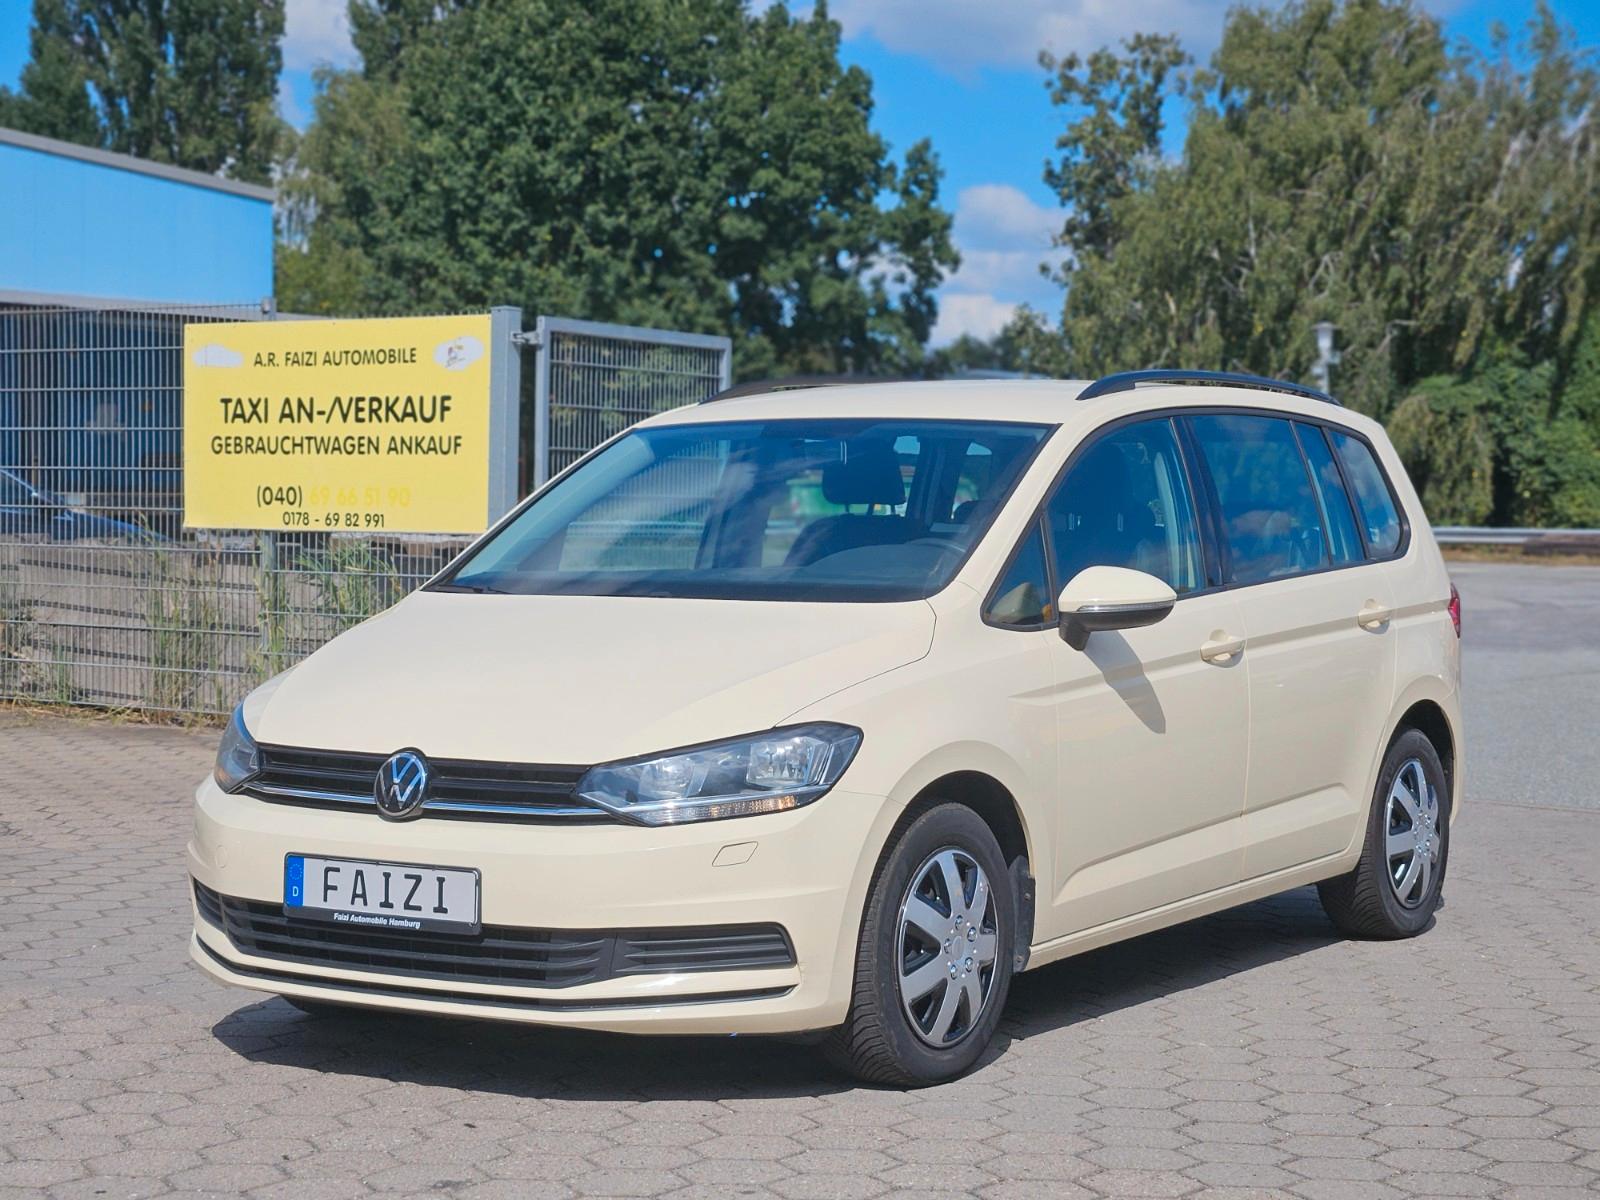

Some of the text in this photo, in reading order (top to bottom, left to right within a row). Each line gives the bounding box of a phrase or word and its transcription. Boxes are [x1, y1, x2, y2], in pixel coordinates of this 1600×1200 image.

[253, 347, 417, 367] A.R. FAIZI AUTOMOBILE
[220, 395, 452, 424] TAXI AN-/VERKAUF
[211, 435, 462, 455] GEBRAUCHTWAGEN ANKAUF
[256, 485, 303, 507] (040)
[309, 486, 330, 506] 69
[282, 511, 310, 527] 0178
[324, 512, 340, 528] 69
[345, 513, 360, 527] 82
[364, 513, 385, 529] 991
[292, 886, 299, 897] D
[323, 866, 449, 914] FAIZI
[333, 912, 420, 929] Faizi Automobile Hamburg
